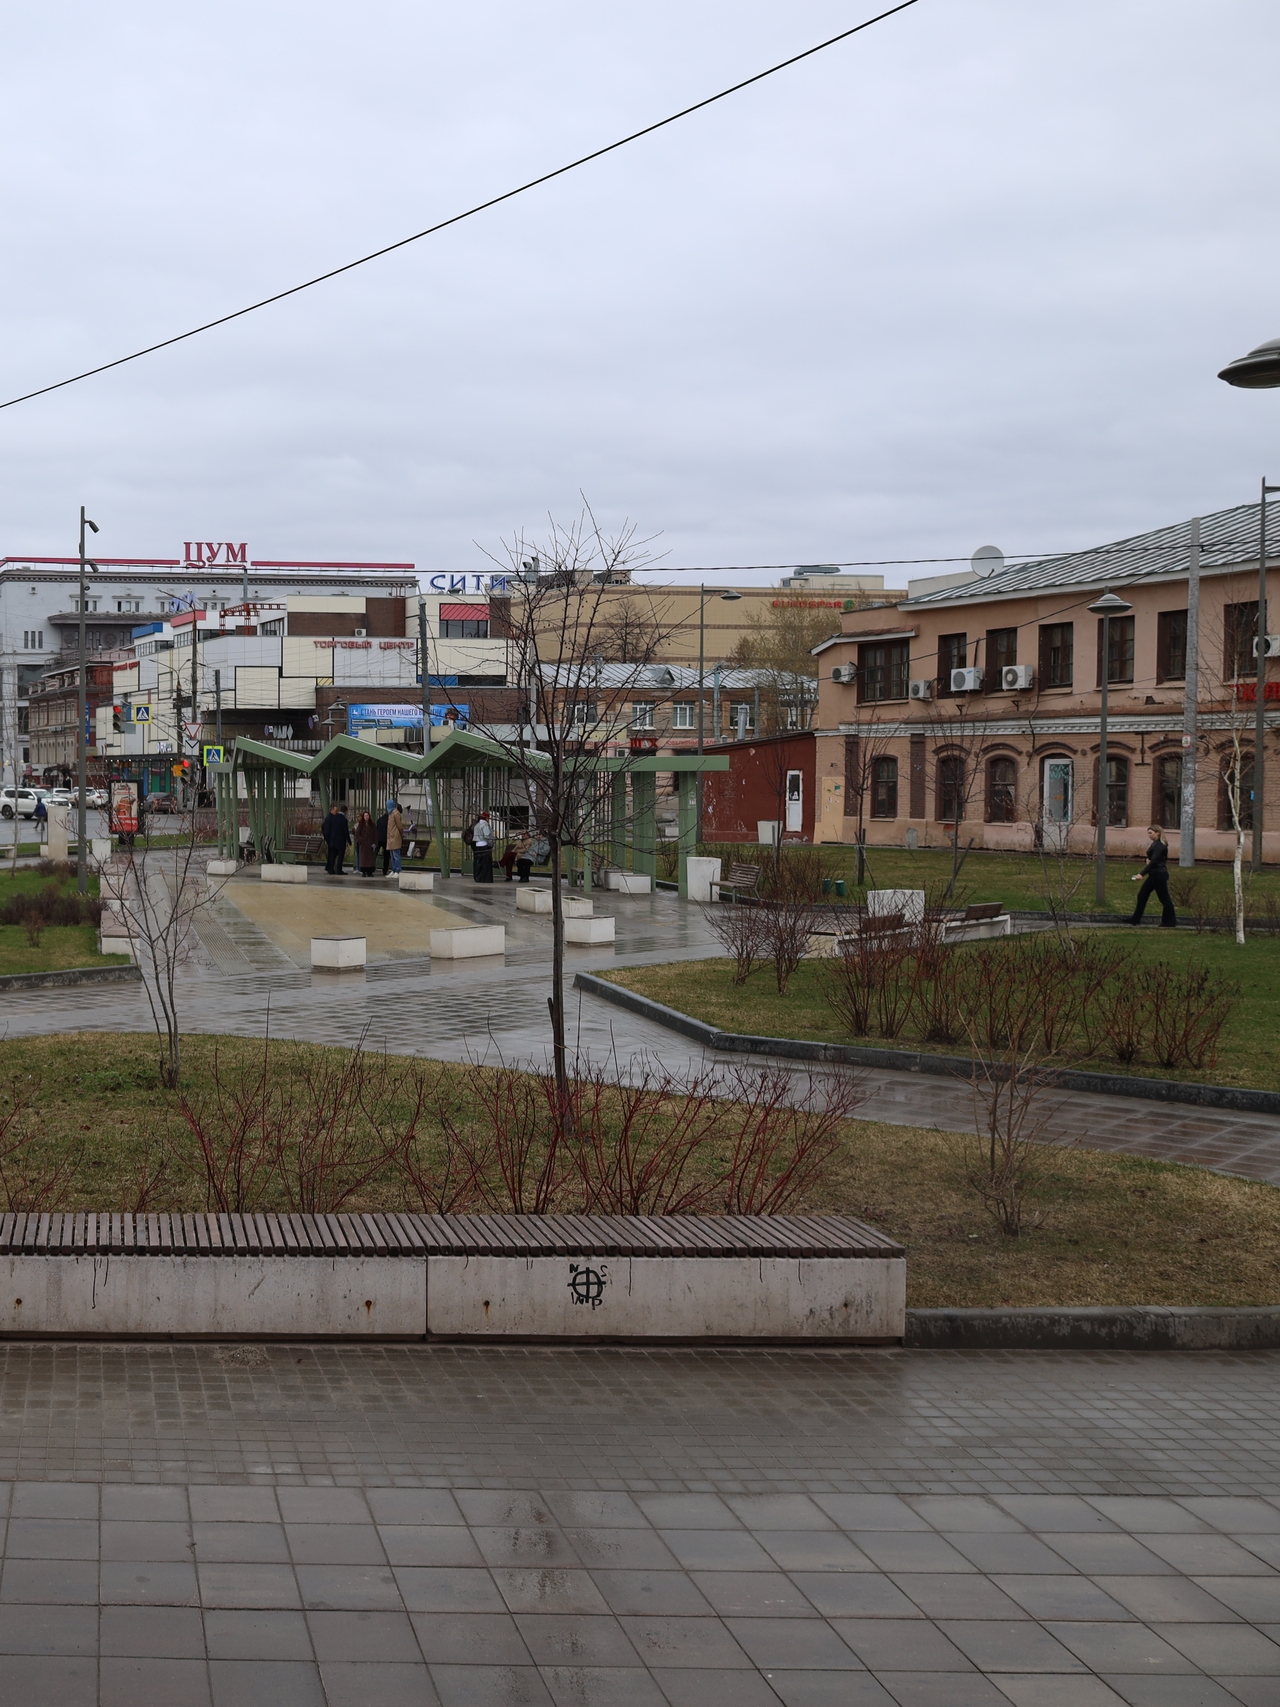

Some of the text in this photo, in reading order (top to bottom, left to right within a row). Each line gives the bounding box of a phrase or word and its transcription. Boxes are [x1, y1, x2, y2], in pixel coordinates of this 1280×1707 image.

[183, 542, 248, 568] ЦУМ
[430, 574, 507, 591] СИТИ
[313, 640, 415, 650] ТОРГОВЫЙ ЦЕНТР
[361, 708, 377, 716] СТАНЬ
[377, 708, 396, 716] ГЕРОЕМ
[397, 708, 418, 716] НАШЕГО
